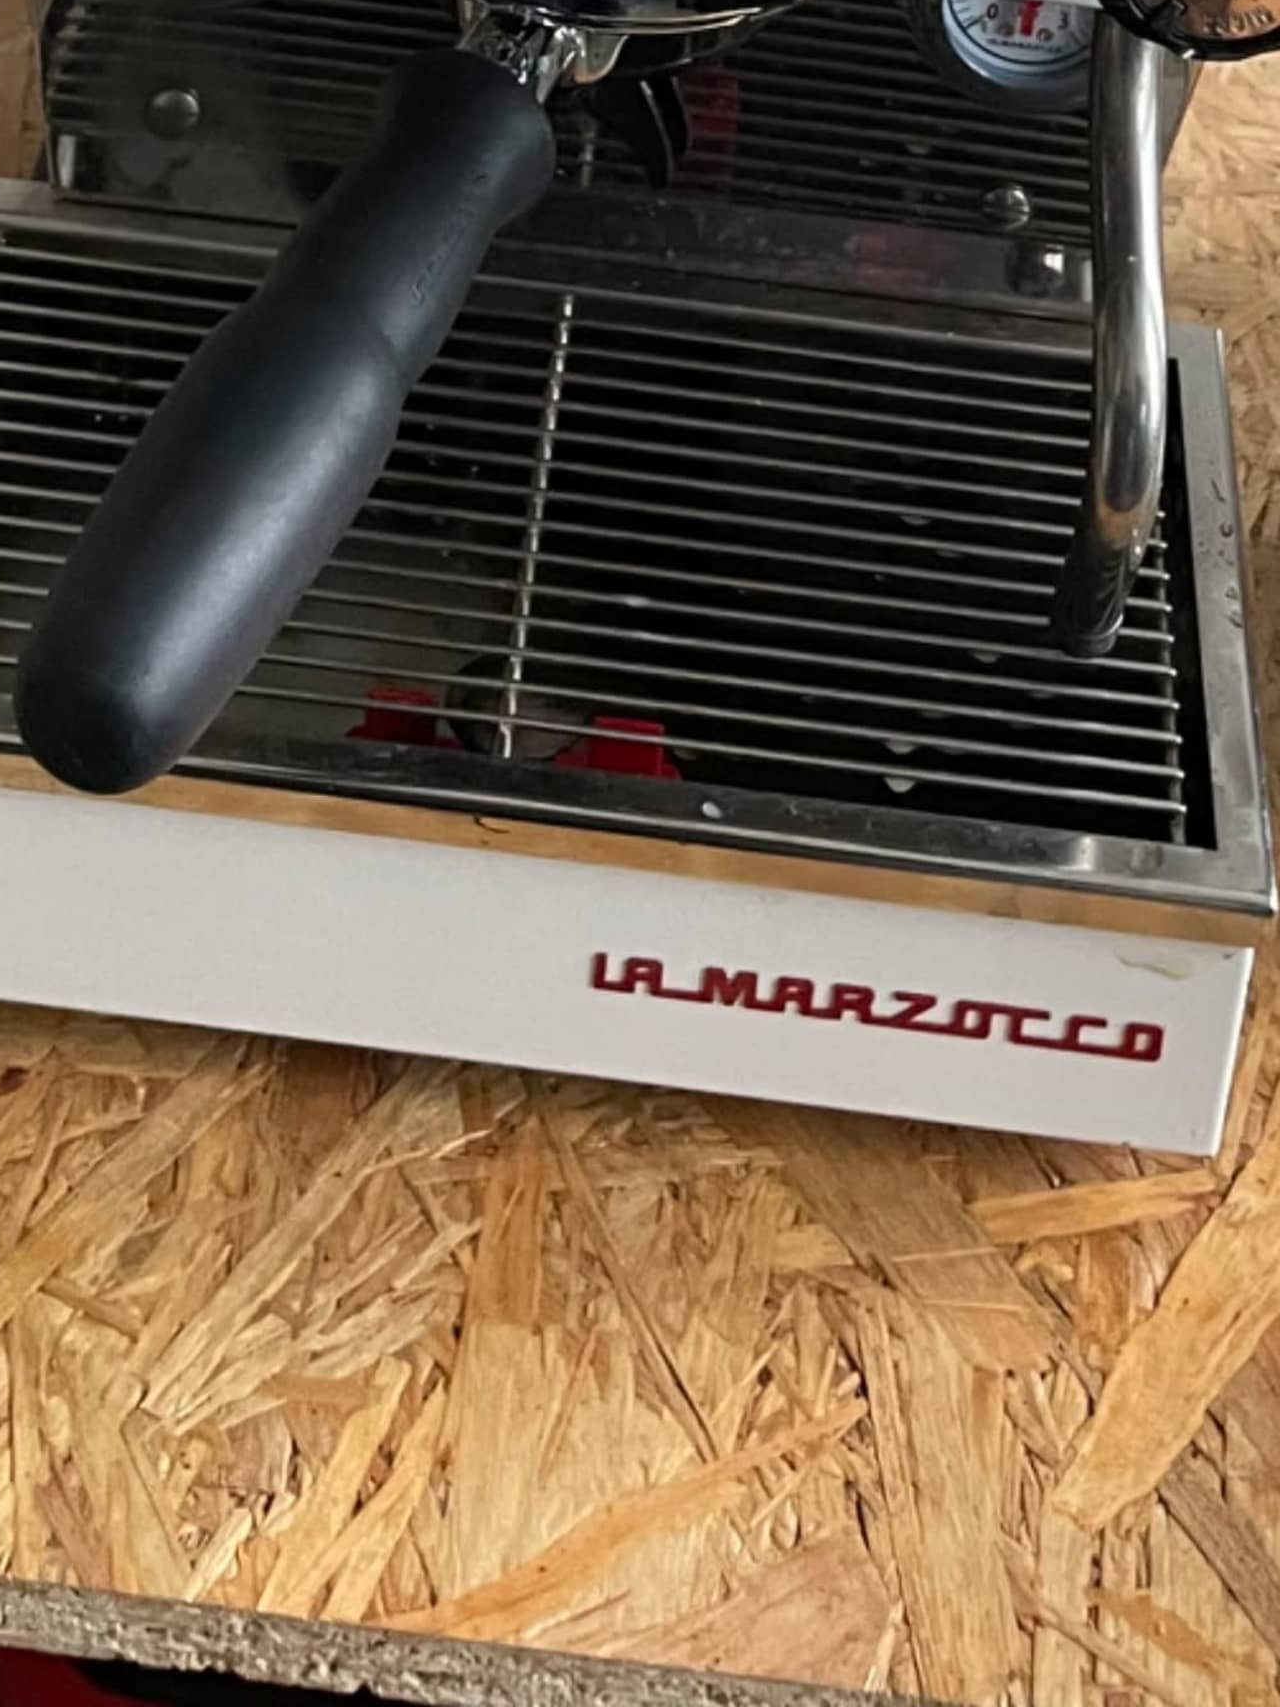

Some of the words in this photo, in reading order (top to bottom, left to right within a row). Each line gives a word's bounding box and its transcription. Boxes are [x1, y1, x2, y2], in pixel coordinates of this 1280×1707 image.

[986, 2, 999, 20] 0
[590, 950, 665, 998] LA
[698, 965, 1166, 1063] MARZOCCO
